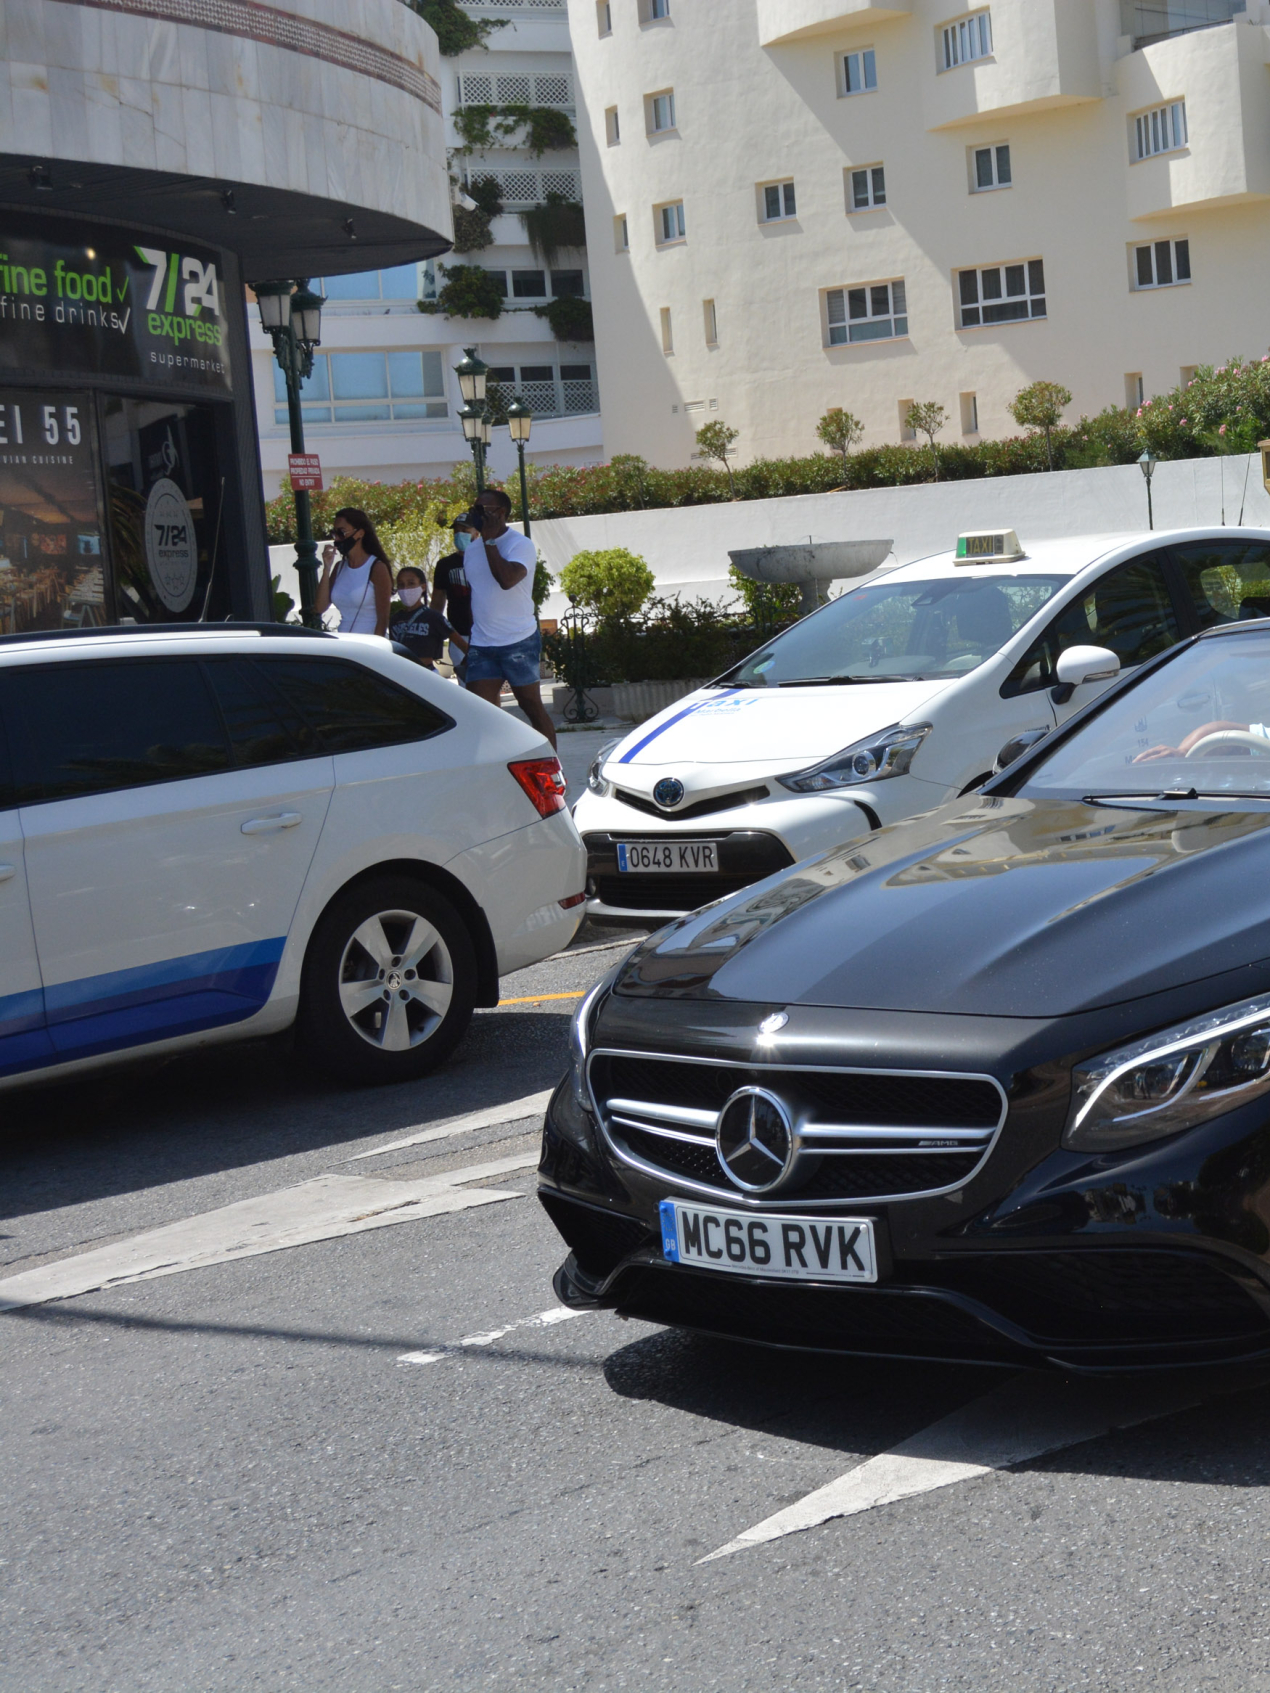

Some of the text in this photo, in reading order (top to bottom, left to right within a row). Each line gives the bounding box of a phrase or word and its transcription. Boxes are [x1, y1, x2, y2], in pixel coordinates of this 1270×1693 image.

[55, 260, 113, 304] food
[133, 245, 220, 316] 7/24
[1, 295, 119, 329] fine drinks
[148, 312, 222, 346] express
[150, 351, 226, 374] supermarket
[44, 406, 81, 446] 55
[32, 455, 73, 465] CUISINE
[158, 549, 189, 560] express
[969, 536, 992, 554] TAXI
[1137, 737, 1149, 748] 154
[630, 845, 714, 868] 0648 KVR
[665, 1238, 676, 1251] GB
[681, 1211, 866, 1272] MC66 RVK
